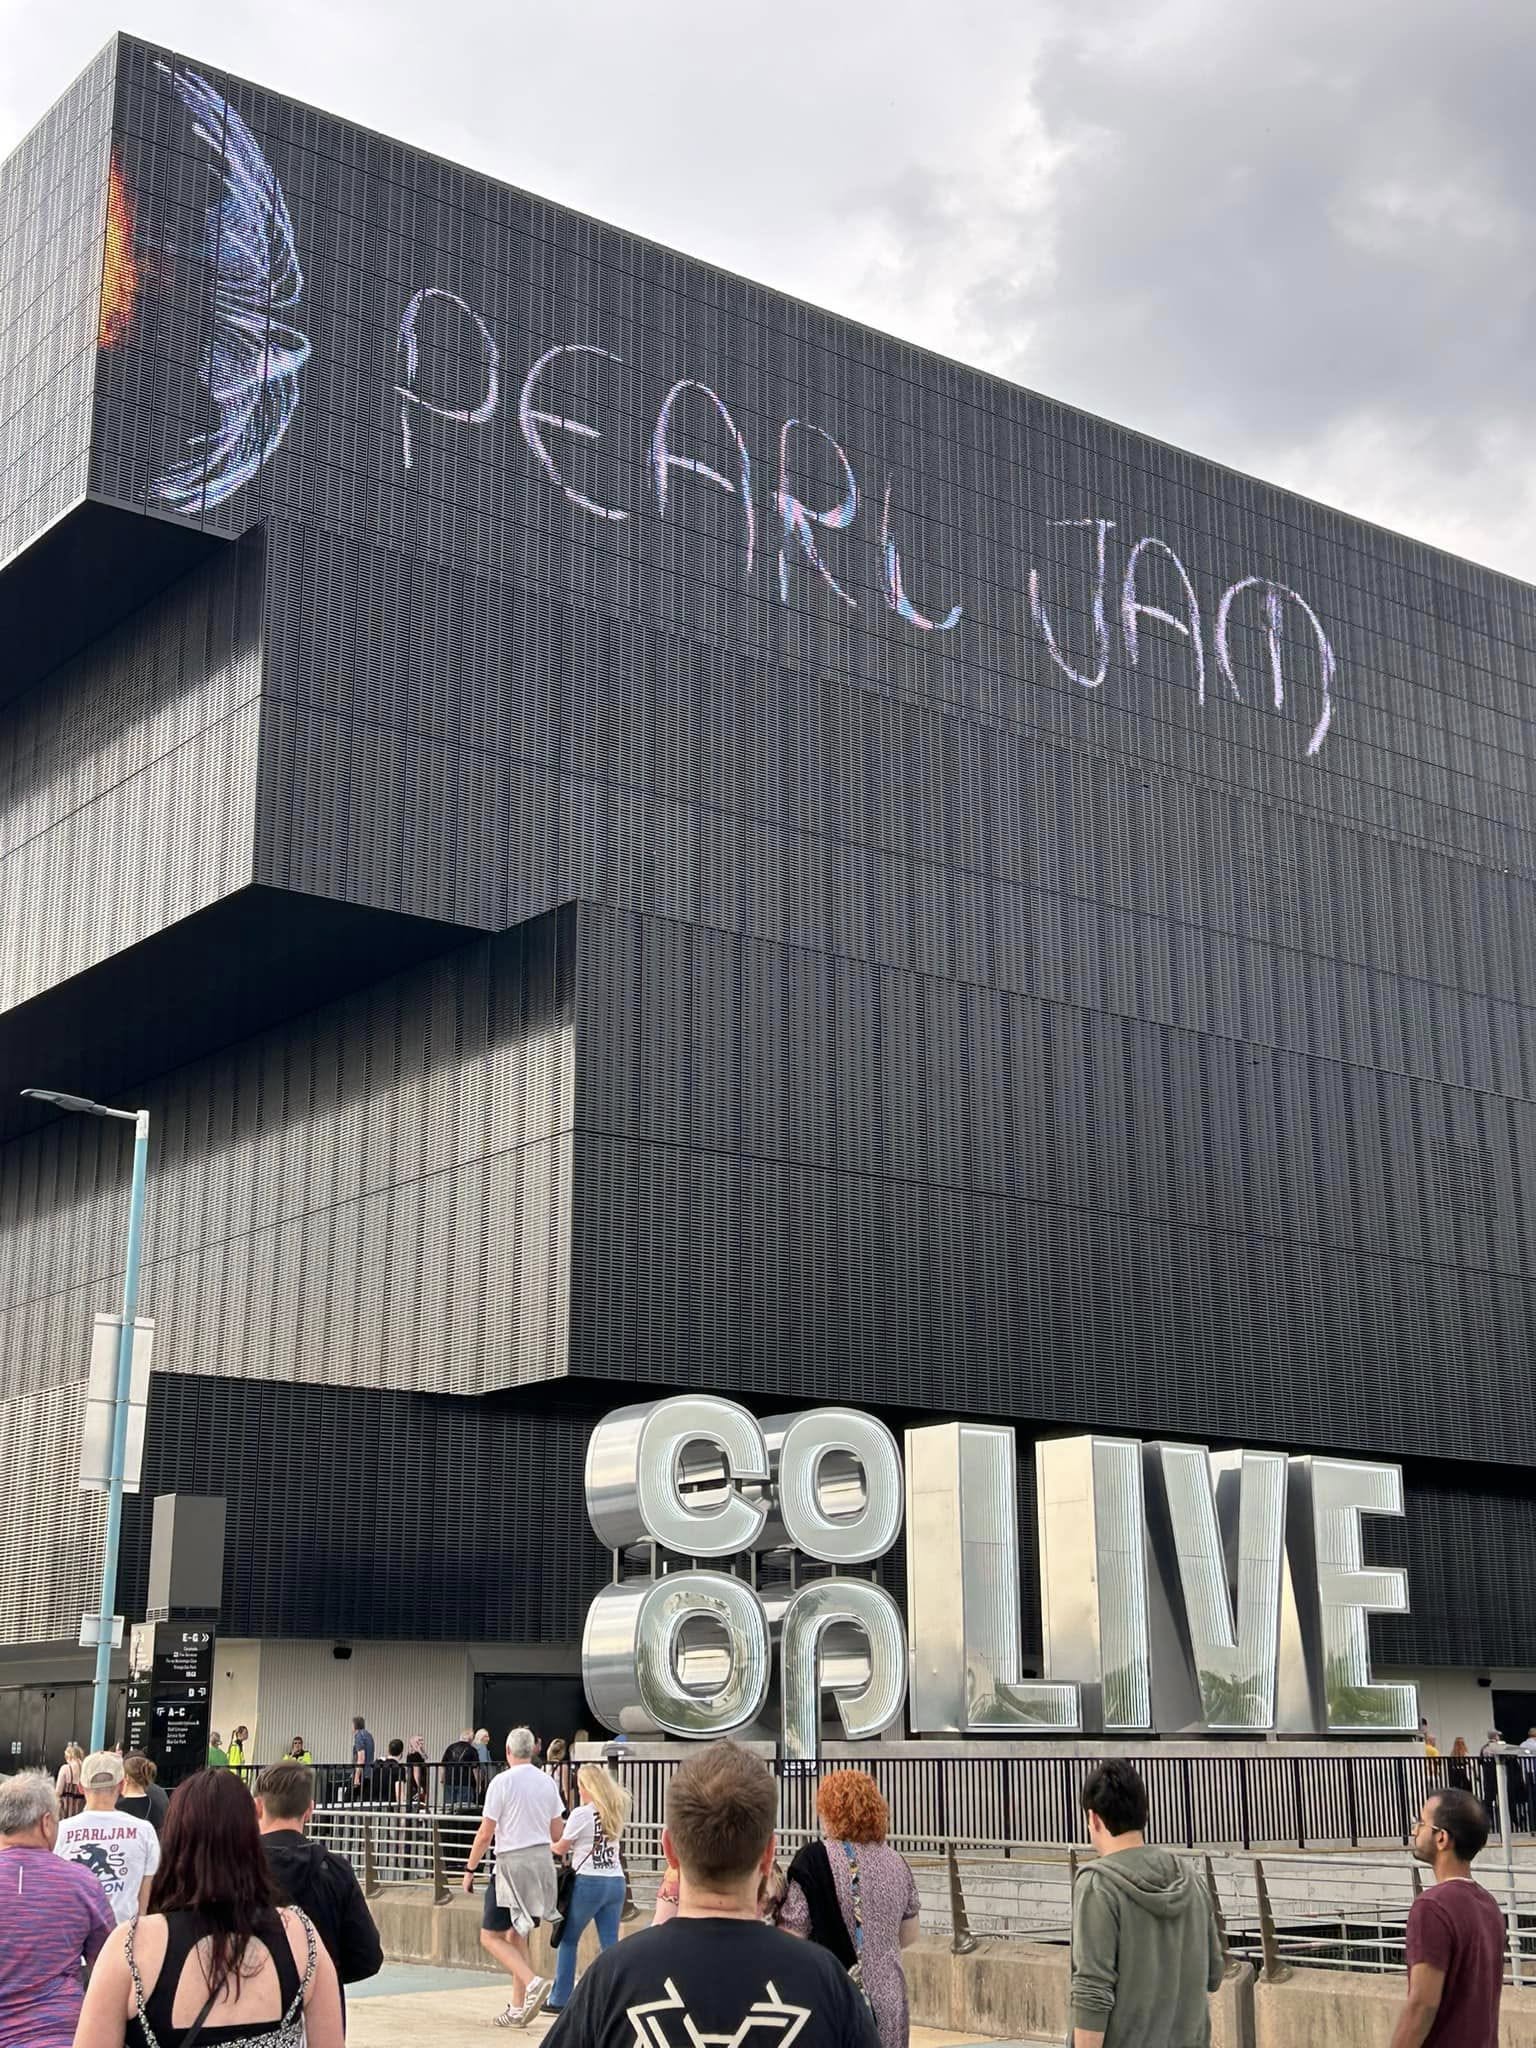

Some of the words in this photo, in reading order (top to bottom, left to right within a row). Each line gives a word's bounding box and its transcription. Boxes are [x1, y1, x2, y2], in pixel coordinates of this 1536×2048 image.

[395, 286, 964, 631] PEARL
[1029, 517, 1337, 757] JAM
[167, 1707, 186, 1717] A-C
[904, 1421, 1421, 1735] LIVE
